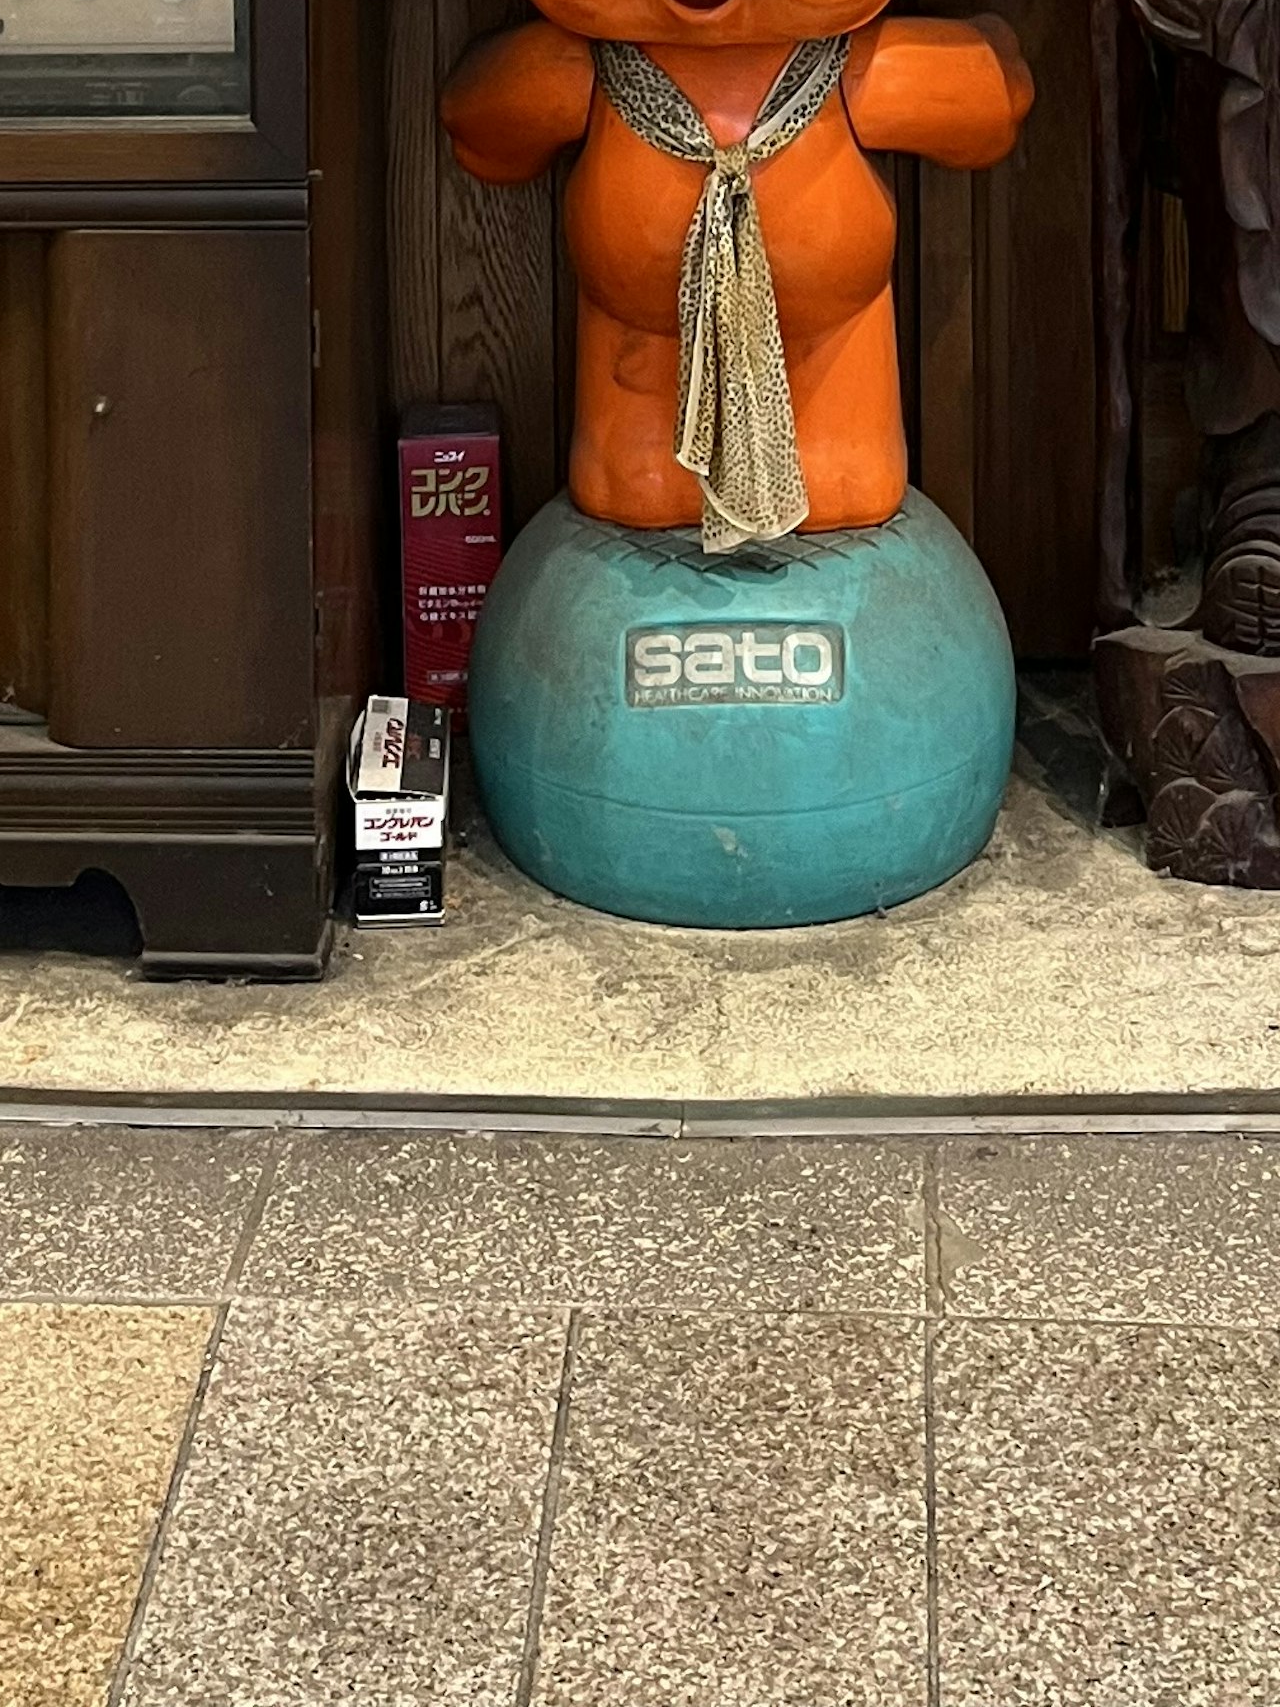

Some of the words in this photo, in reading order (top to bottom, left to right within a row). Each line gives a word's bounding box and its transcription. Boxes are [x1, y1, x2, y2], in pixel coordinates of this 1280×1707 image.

[411, 466, 490, 492] コンク
[411, 492, 489, 517] レバン
[634, 632, 834, 686] sato
[634, 688, 728, 704] HEALTHCARE
[734, 687, 833, 703] INNOVATION
[363, 816, 435, 831] コンクレバン
[380, 831, 418, 843] ゴールド
